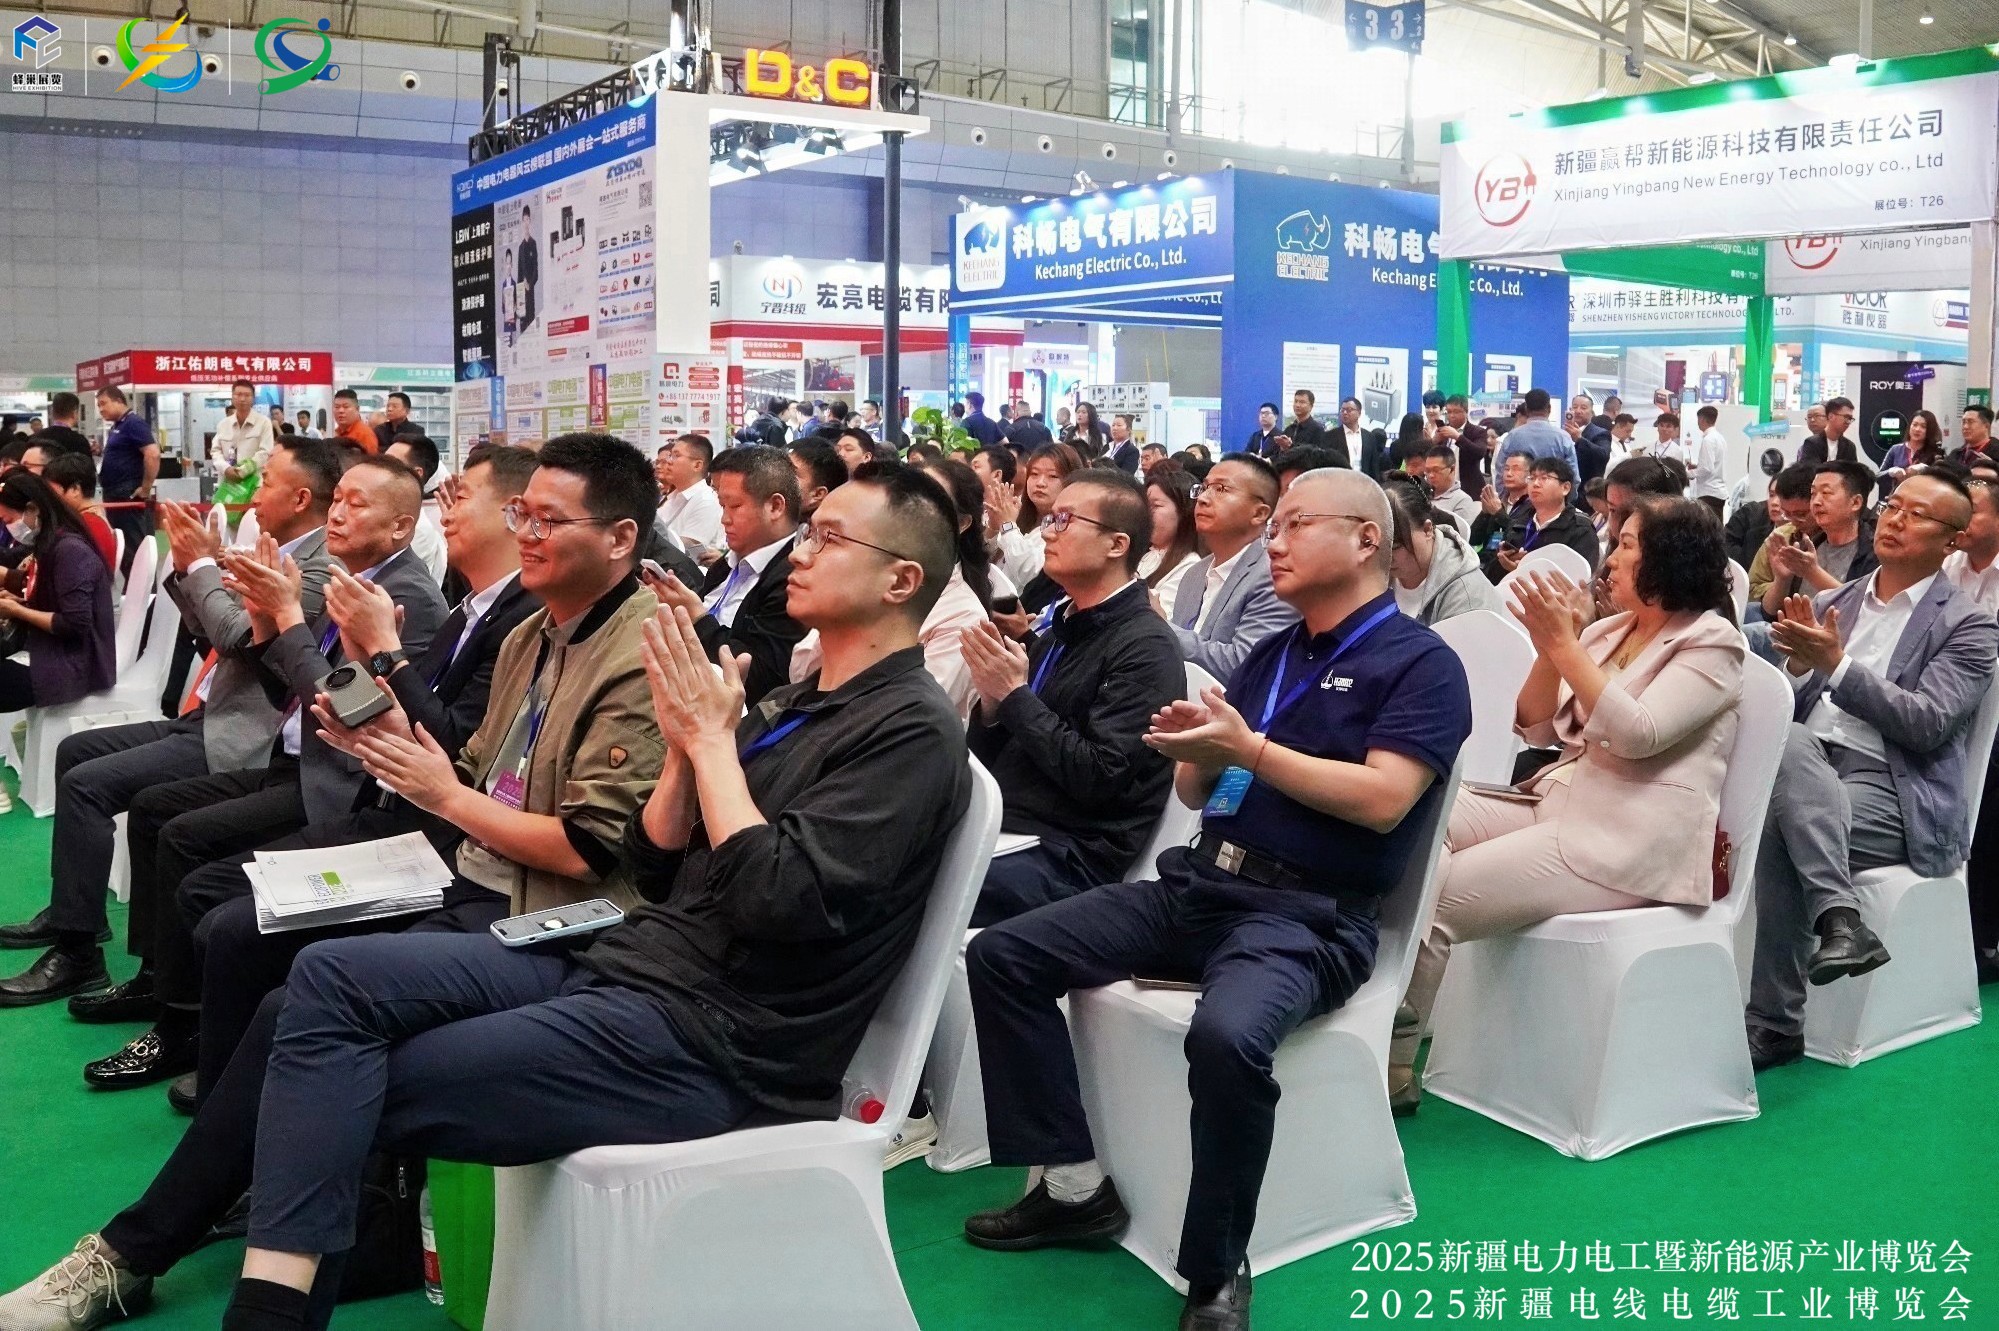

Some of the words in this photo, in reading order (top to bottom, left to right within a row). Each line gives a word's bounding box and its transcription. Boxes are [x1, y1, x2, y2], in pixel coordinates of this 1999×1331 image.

[1365, 9, 1379, 41] 3
[1390, 9, 1404, 41] 3
[1554, 108, 1945, 178] 新疆赢帮新能源科技有限责任公司
[1554, 182, 1610, 203] Xinjiang
[1613, 179, 1680, 199] Yingbang
[1683, 174, 1717, 191] New
[1720, 170, 1775, 190] Energy
[1779, 163, 1875, 184] Technology
[1878, 160, 1911, 173] co.,
[1915, 152, 1945, 169] Ltd
[1484, 176, 1522, 204] YB
[1012, 195, 1217, 260] 科畅电气有限公司
[1860, 237, 1911, 251] Xinjiang
[1035, 260, 1084, 281] Kechang
[1085, 253, 1132, 275] Electric
[1134, 252, 1159, 271] Co.,
[1161, 246, 1187, 266] Ltd.
[1277, 251, 1329, 267] KECHANG
[1277, 264, 1329, 281] ELECTRIC
[1372, 266, 1427, 291] Kechang
[1477, 277, 1500, 297] Co.,
[1502, 280, 1524, 296] Ltd.
[1583, 289, 1791, 310] 深圳市驿生胜利科技有
[1582, 314, 1624, 323] SHENZHEN
[1624, 312, 1659, 322] YISHENG
[1661, 311, 1695, 320] VICTORY
[1696, 309, 1747, 319] TECHNOLO
[1774, 306, 1795, 316] LTD.
[1842, 309, 1887, 329] 胜利仪器
[155, 356, 312, 372] 浙江佑朗电气有限公司
[1869, 381, 1895, 390] ROY
